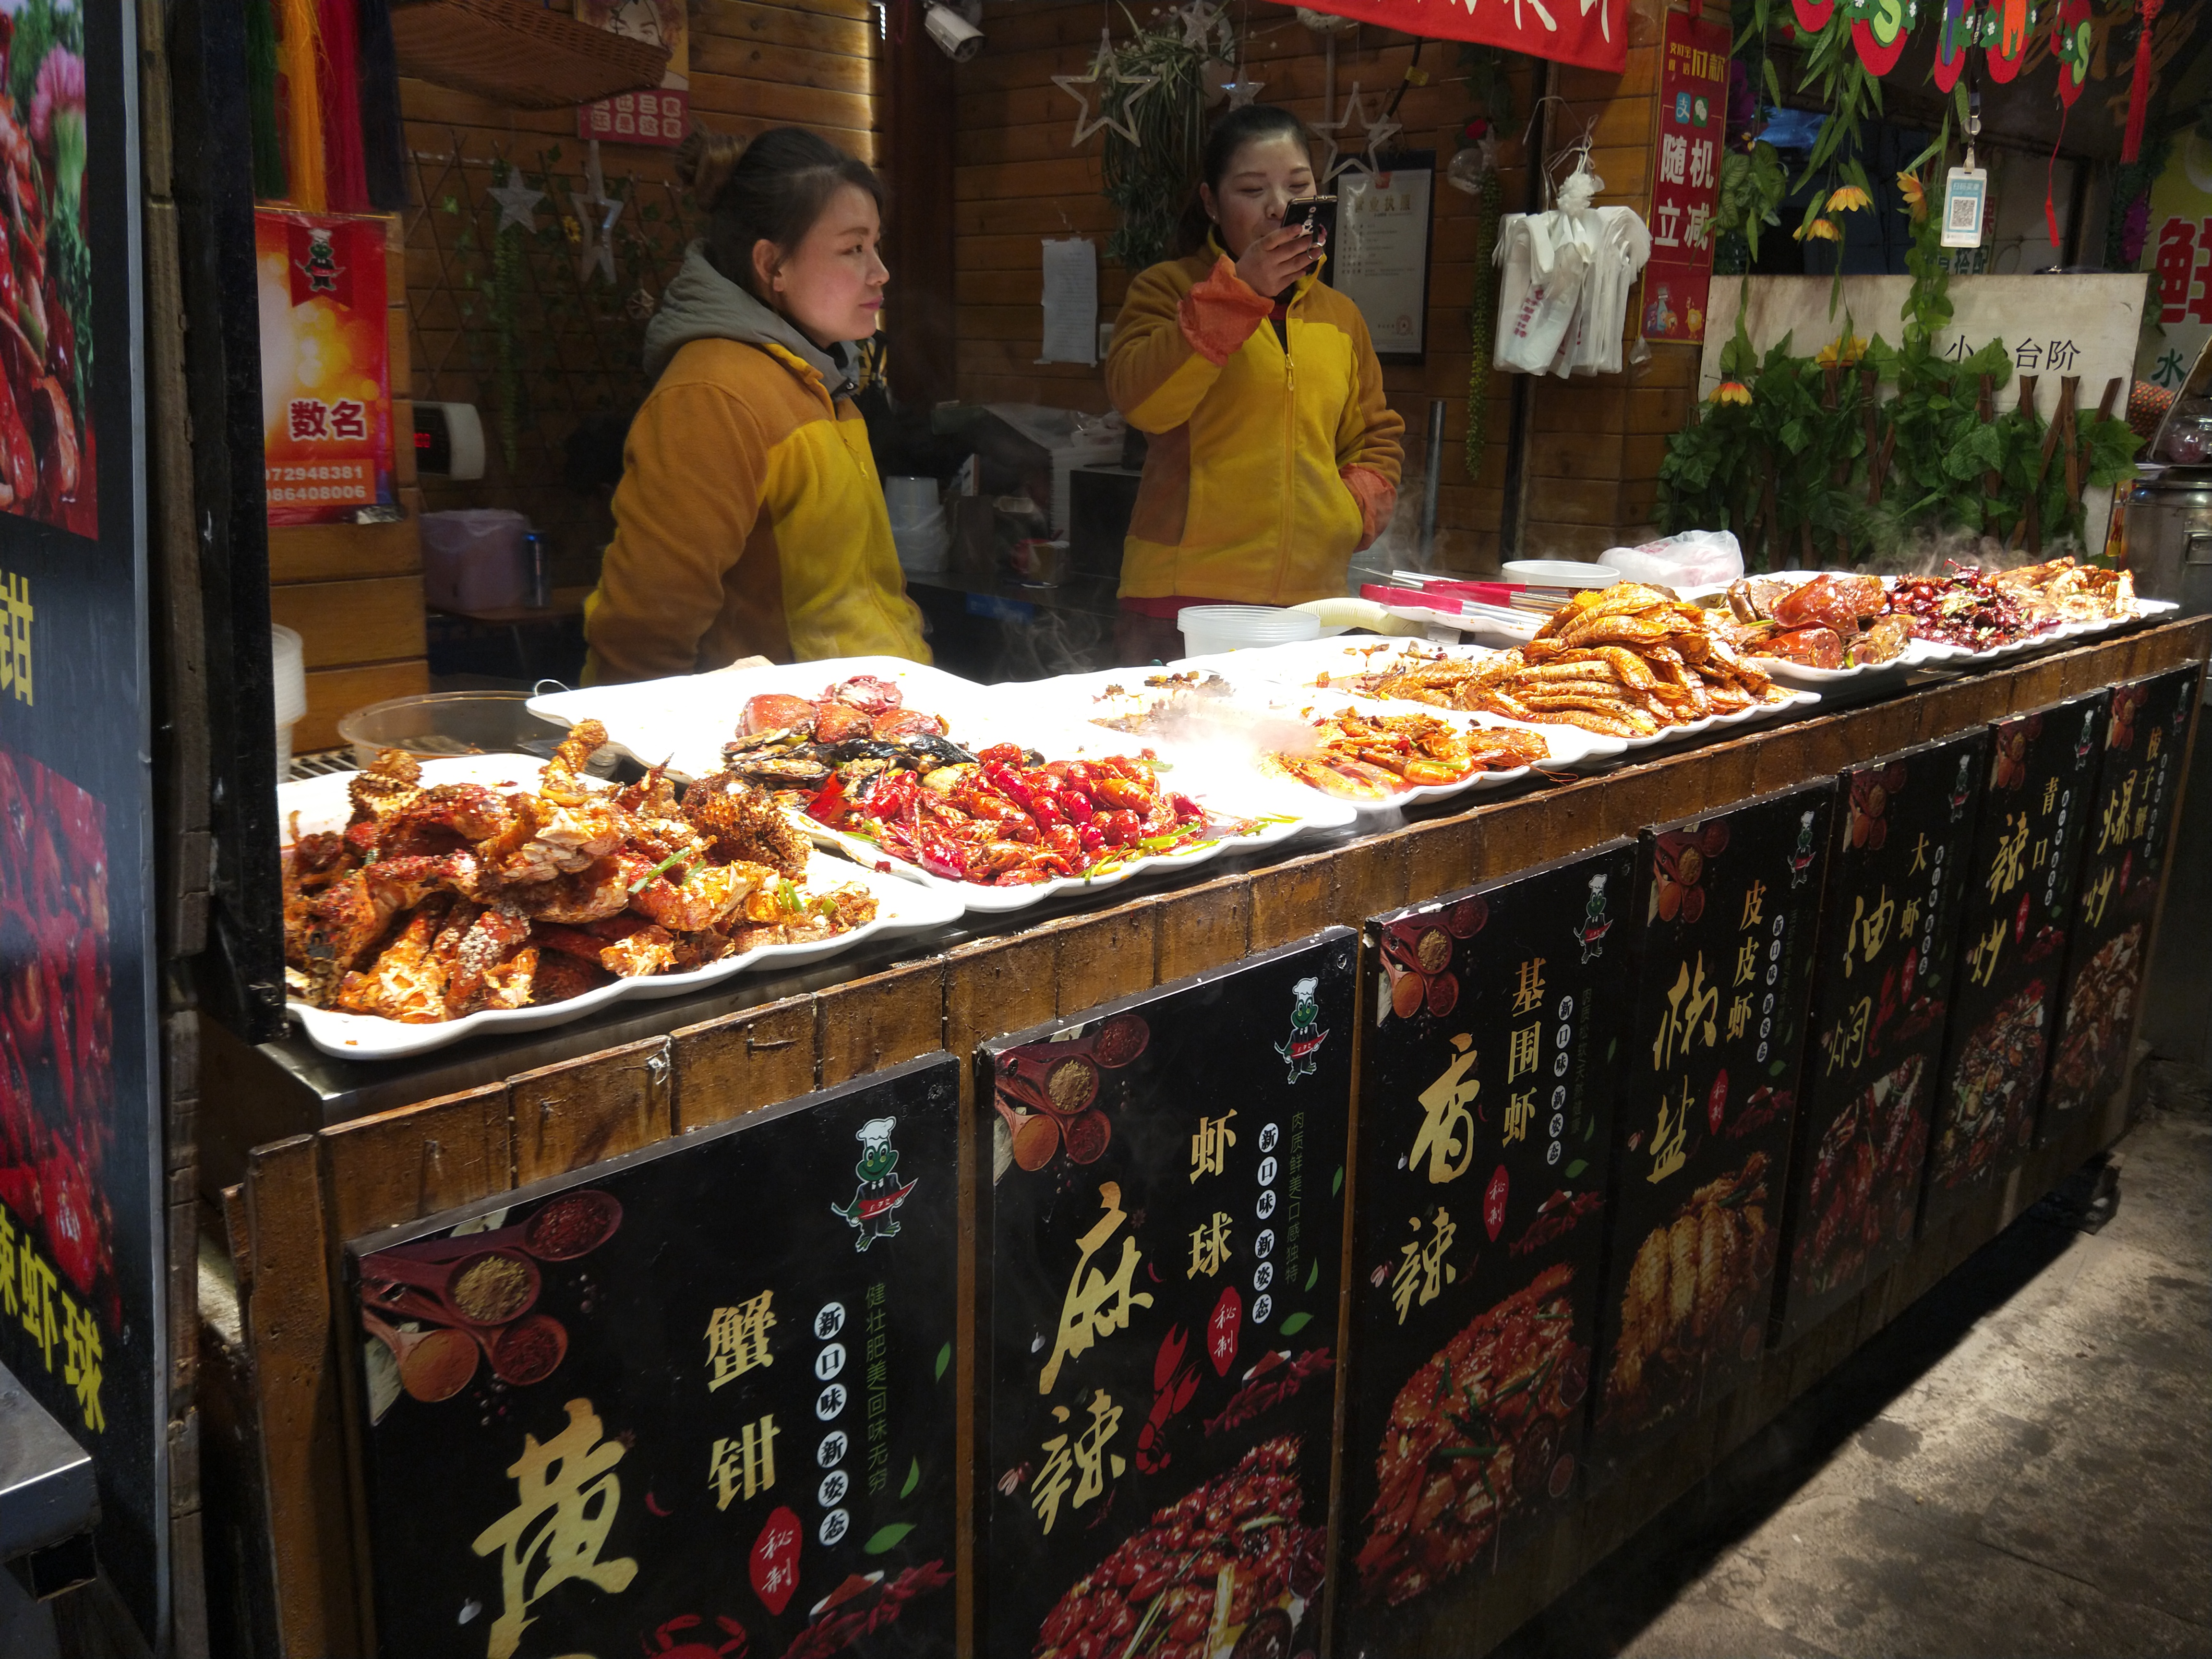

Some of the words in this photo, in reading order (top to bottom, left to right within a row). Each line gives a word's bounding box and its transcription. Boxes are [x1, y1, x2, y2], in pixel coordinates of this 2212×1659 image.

[1692, 49, 1726, 83] 付款
[1659, 133, 1714, 189] 随机
[1654, 197, 1710, 251] 立减
[1945, 335, 2081, 372] 小台阶
[2151, 348, 2187, 388] 水
[290, 398, 366, 441] 数名
[2032, 776, 2059, 871] 青口
[2084, 769, 2138, 927] 爆炒
[1899, 832, 1929, 940] 大虾
[1971, 811, 2030, 987] 辣炒
[1726, 879, 1766, 1044] 皮皮虾
[1827, 884, 1895, 1078] 油焖
[1502, 957, 1547, 1148] 基围虾
[1555, 997, 1572, 1074] 新口味
[1647, 950, 1718, 1184] 椒盐
[1258, 1125, 1277, 1217] 新口味
[1548, 1087, 1564, 1163] 新姿态
[1186, 1107, 1237, 1280] 虾球
[1391, 1032, 1481, 1326] 香辣
[1253, 1230, 1273, 1321] 新姿态
[816, 1304, 845, 1418] 新口味
[1030, 1180, 1154, 1535] 麻辣
[1214, 1304, 1236, 1358] 秘制
[819, 1433, 847, 1542] 新姿态
